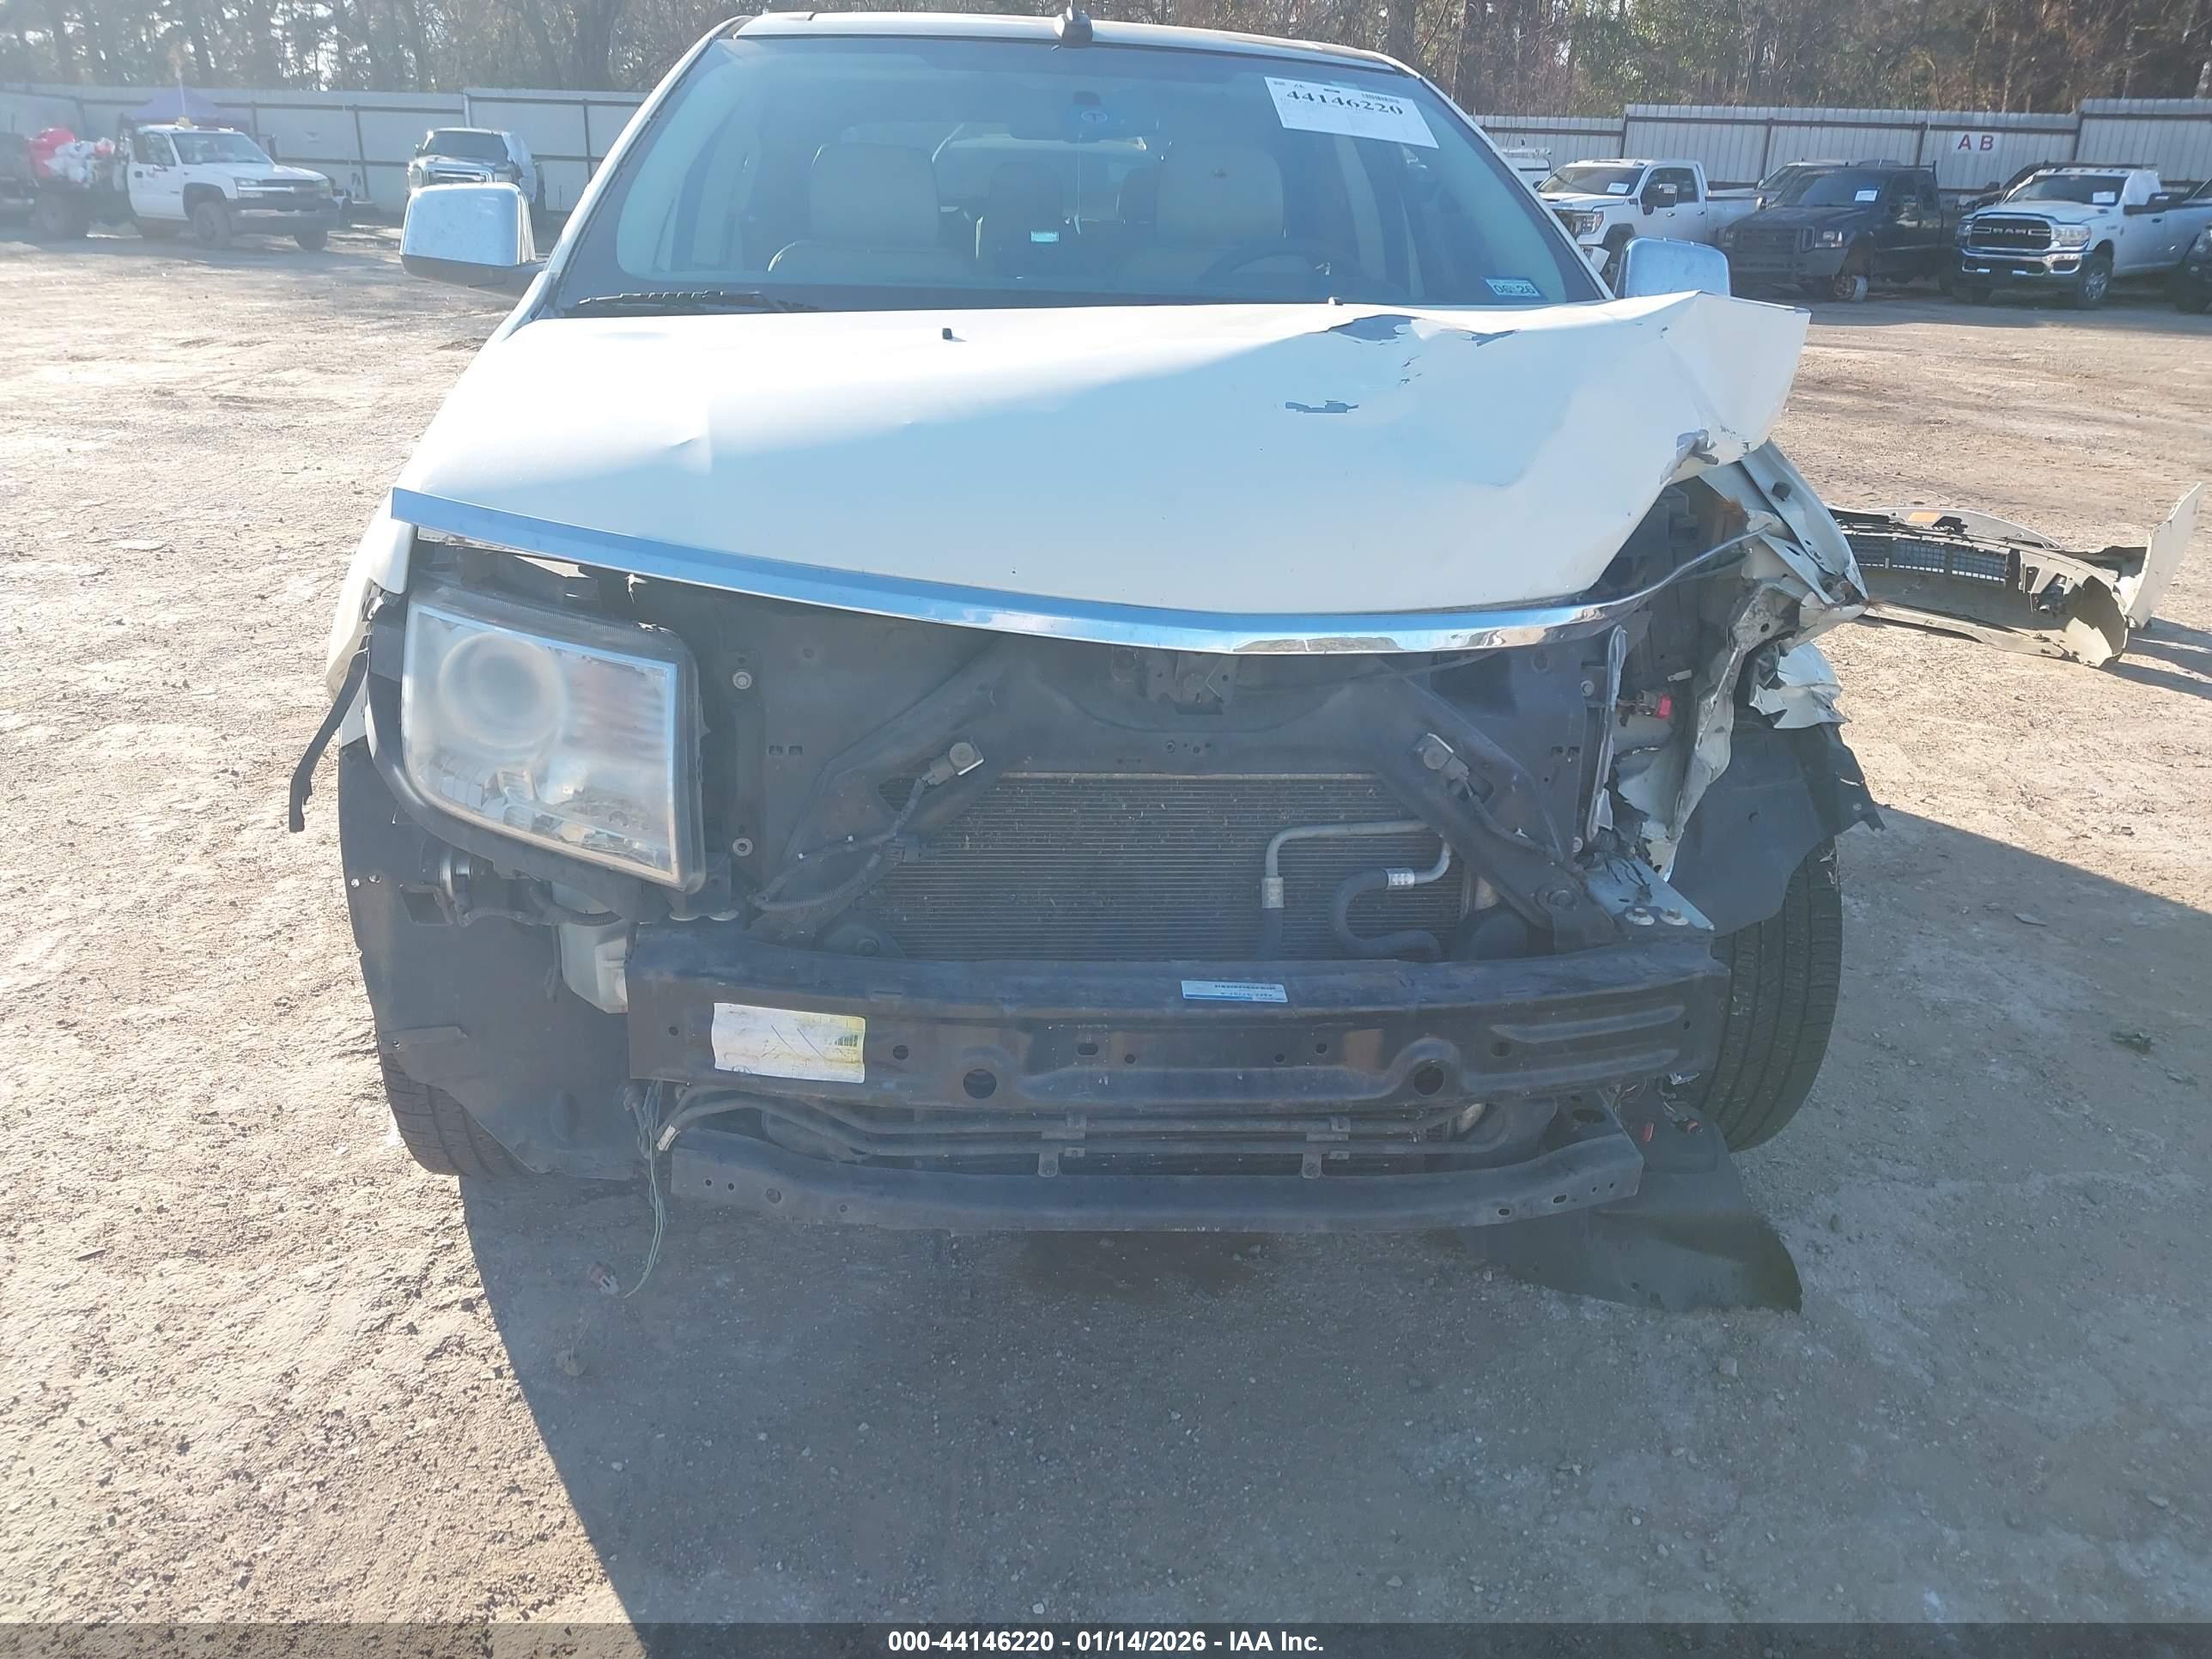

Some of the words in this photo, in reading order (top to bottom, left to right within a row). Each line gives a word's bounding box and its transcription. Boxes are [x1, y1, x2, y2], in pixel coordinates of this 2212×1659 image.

[1286, 89, 1404, 115] 44146220
[1957, 134, 1972, 150] A
[1979, 135, 1994, 151] B
